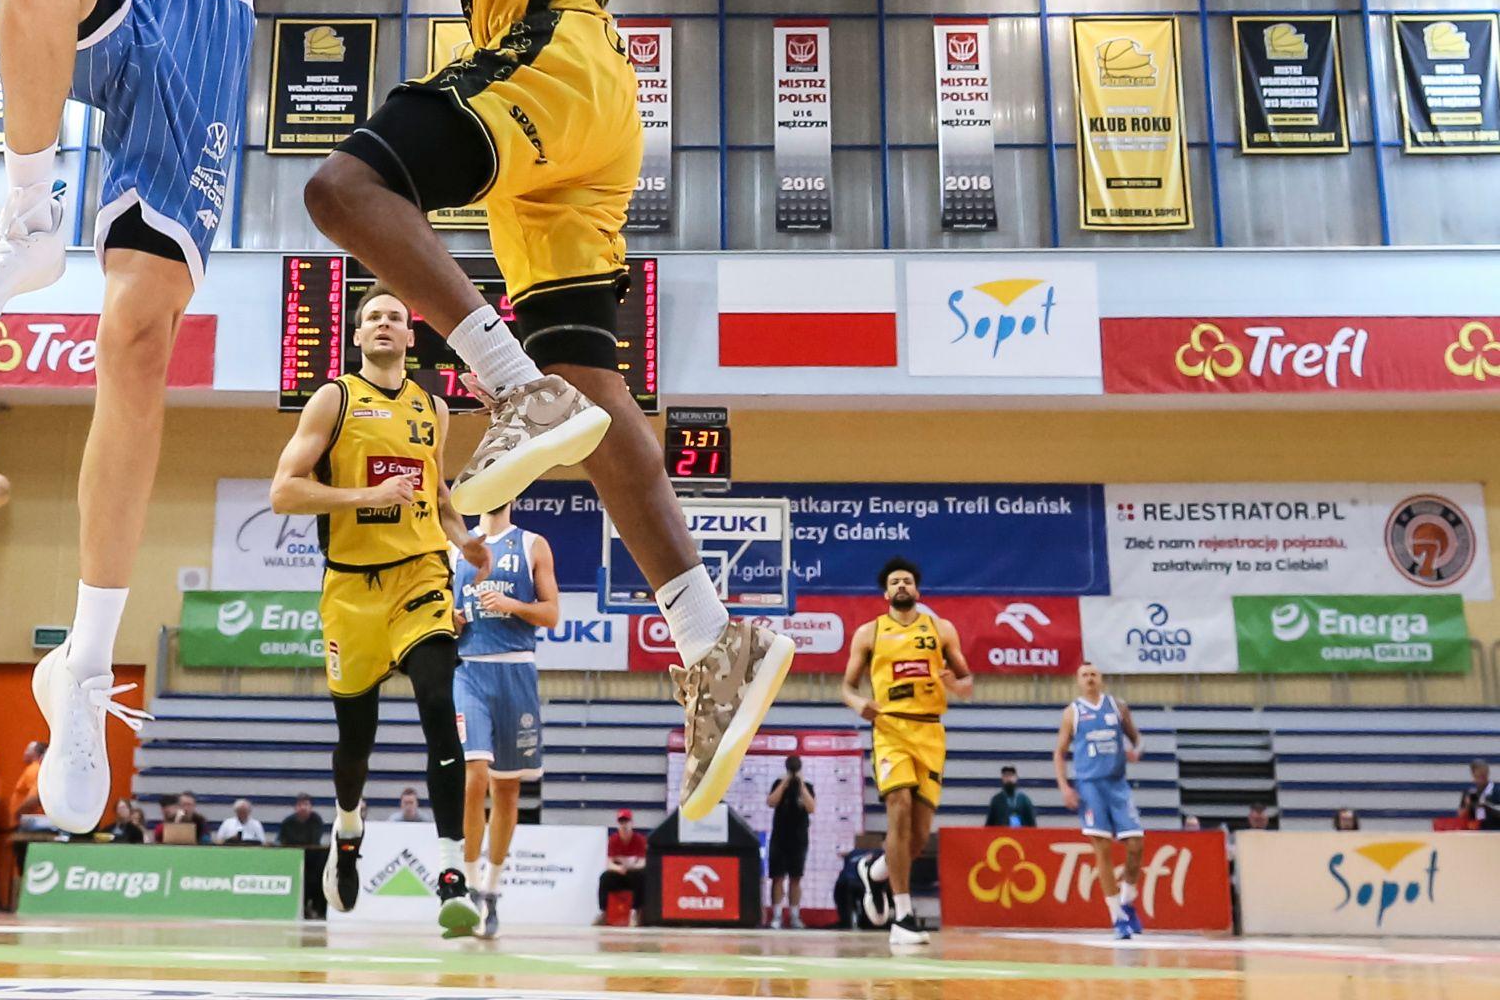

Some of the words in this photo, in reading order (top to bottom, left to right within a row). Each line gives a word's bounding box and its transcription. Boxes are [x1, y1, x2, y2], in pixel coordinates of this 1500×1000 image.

[637, 79, 668, 89] STRZ
[778, 79, 826, 88] MISTRZ
[940, 77, 988, 86] MISTRZ
[636, 94, 668, 103] LSKI
[778, 94, 826, 103] POLSKI
[941, 92, 989, 101] POLSKI
[1089, 117, 1127, 132] KLUB
[1131, 116, 1172, 132] ROKU
[636, 176, 666, 191] 015
[781, 177, 826, 190] 2016
[944, 175, 992, 191] 2018
[947, 285, 1057, 359] Sopot
[25, 323, 98, 373] Tre
[1244, 326, 1369, 388] Trefl
[669, 412, 726, 420] AEROWATCH
[406, 419, 434, 446] 13
[681, 430, 719, 447] 7.37
[676, 450, 719, 476] 21
[512, 497, 565, 515] karzy
[789, 497, 863, 518] atkarzy
[869, 497, 939, 518] Energa
[944, 497, 989, 513] Trefl
[995, 497, 1072, 514] Gdańsk
[1143, 501, 1346, 521] REJESTRATOR.PL
[688, 515, 766, 532] UZUKI
[834, 522, 910, 540] Gdańsk
[1124, 535, 1156, 550] Zleć
[1159, 538, 1195, 550] nam
[1198, 535, 1279, 553] rejestrację
[1282, 535, 1348, 552] pojazdu,
[497, 553, 520, 573] 41
[1152, 559, 1232, 575] załatwimy
[1236, 560, 1251, 571] to
[1255, 561, 1272, 571] za
[1276, 559, 1329, 571] Ciebie!
[783, 618, 832, 631] Basket
[1318, 607, 1428, 641] Energa
[914, 636, 937, 650] 33
[1126, 628, 1192, 646] nata
[260, 642, 308, 655] GRUPA
[1138, 647, 1187, 665] aqua
[1320, 647, 1373, 661] GRUPA
[1377, 646, 1429, 660] ORLEN
[988, 649, 1059, 666] ORLEN
[364, 857, 402, 894] LEROY
[401, 848, 438, 890] MERLI
[1050, 841, 1193, 918] Trfl
[64, 866, 160, 898] Energa
[180, 876, 232, 890] GRUPA
[237, 879, 288, 890] ORLEN
[1328, 849, 1439, 928] Sopot
[677, 896, 724, 910] ORLEN
